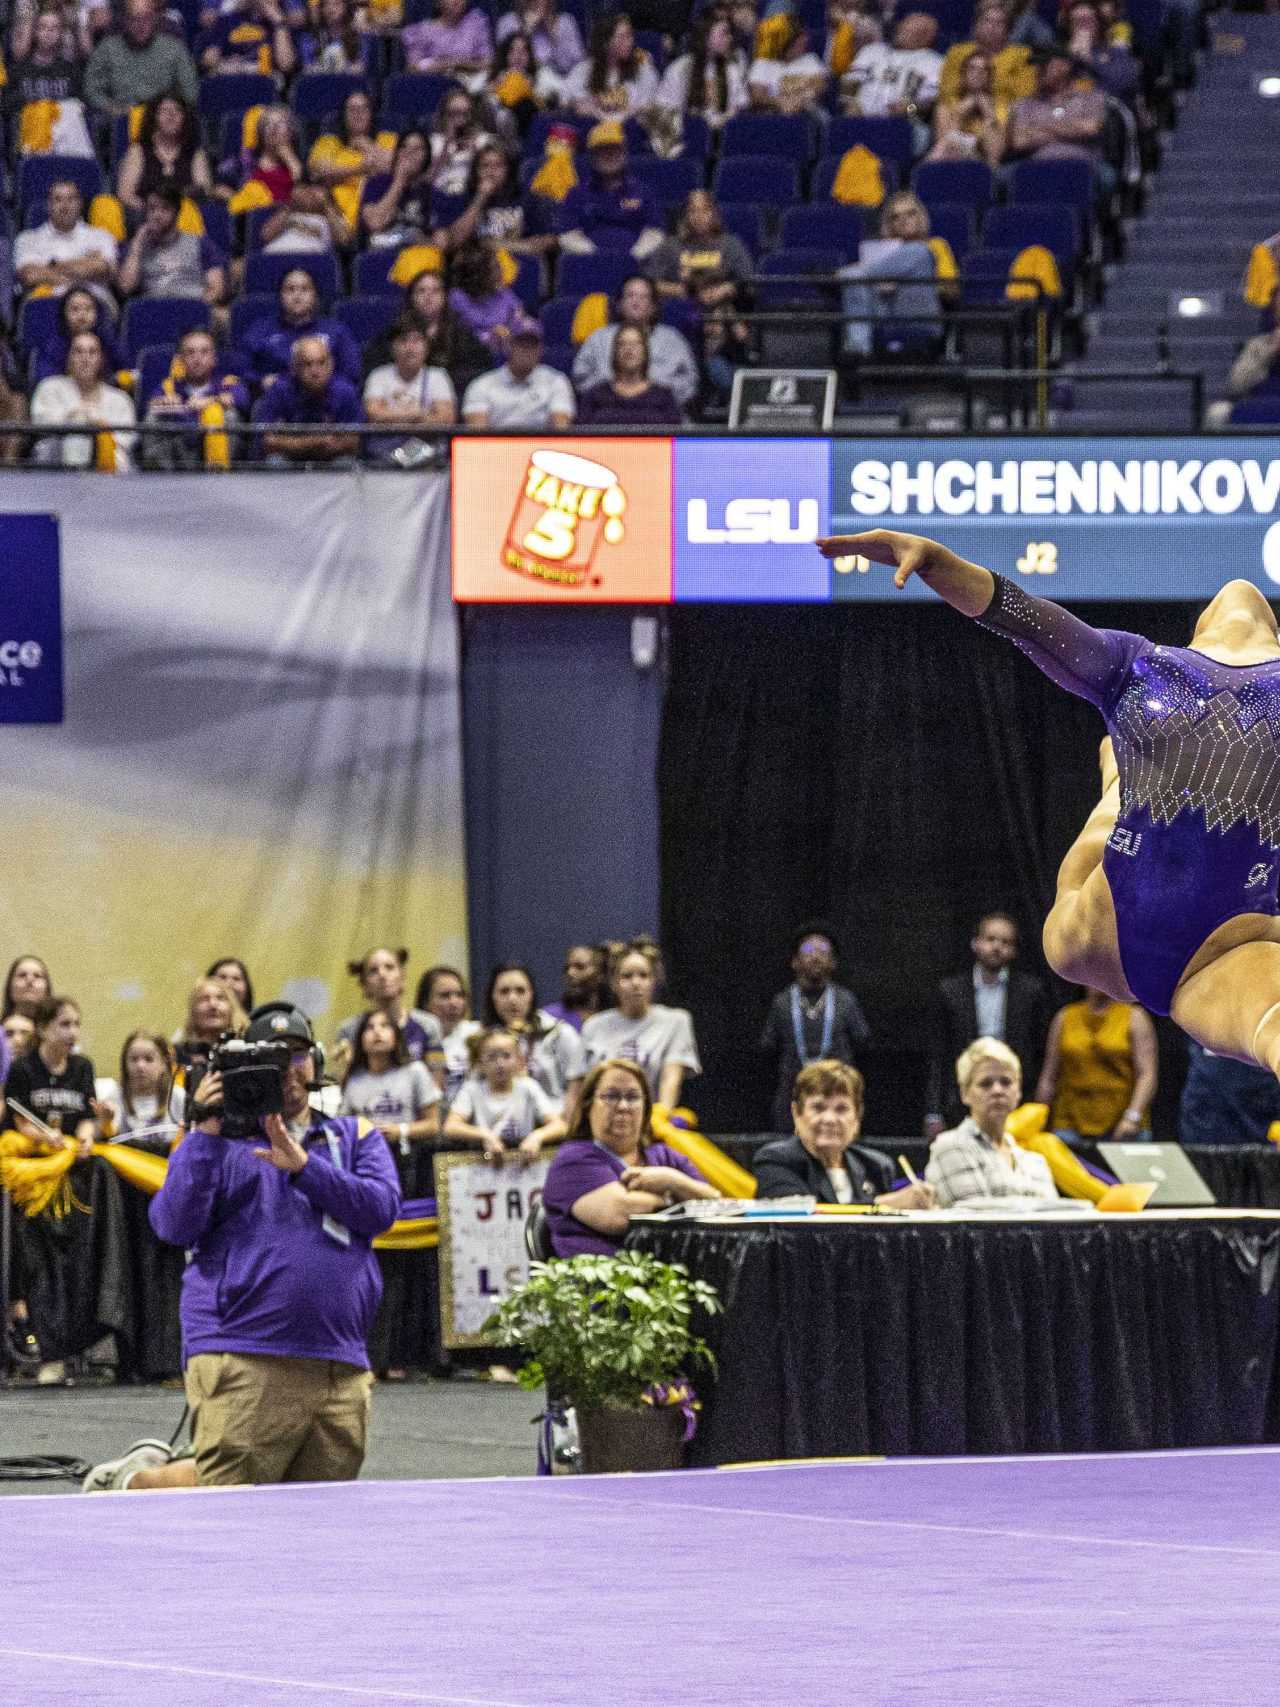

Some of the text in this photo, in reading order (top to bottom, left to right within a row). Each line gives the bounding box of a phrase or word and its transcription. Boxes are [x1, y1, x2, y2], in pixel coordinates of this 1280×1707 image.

[523, 508, 577, 560] 5
[687, 498, 818, 544] LSU
[1016, 542, 1057, 574] J2
